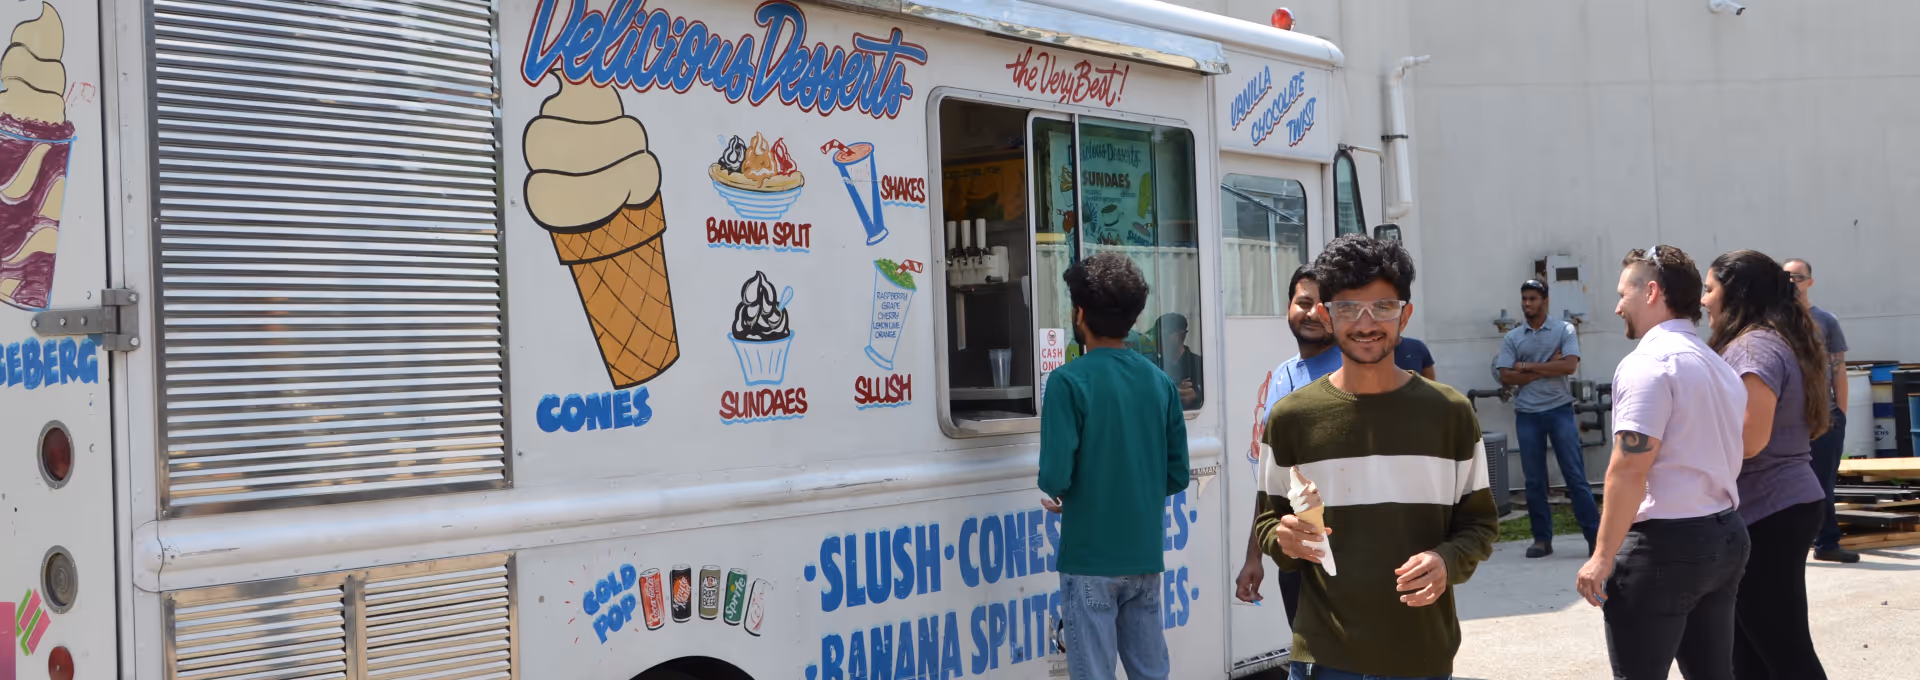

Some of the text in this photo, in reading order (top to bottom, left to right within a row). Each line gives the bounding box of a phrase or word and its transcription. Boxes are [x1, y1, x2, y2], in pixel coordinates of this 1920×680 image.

[520, 0, 928, 119] Delicious Desserts
[1006, 46, 1129, 107] the Very Best!
[1231, 65, 1272, 127] VANILLA
[1251, 71, 1304, 143] CHOCOLATE
[1286, 97, 1317, 143] TWIST
[880, 174, 926, 204] SHAKES
[1082, 170, 1131, 189] SUNDAES
[706, 216, 812, 249] BANANA SPLIT
[876, 291, 908, 301] RASPBERRY
[877, 311, 900, 320] CHERRY
[881, 301, 900, 310] GRAPE
[875, 330, 897, 339] ORANGE
[536, 386, 653, 433] CONES
[719, 387, 809, 420] SUNDAES
[854, 373, 912, 405] SLUSH
[819, 521, 942, 613] SLUSH
[958, 508, 1063, 588] CONES
[583, 563, 637, 616] COLD
[725, 577, 746, 620] Sprite
[592, 593, 637, 645] POP
[821, 611, 963, 680] BANANA
